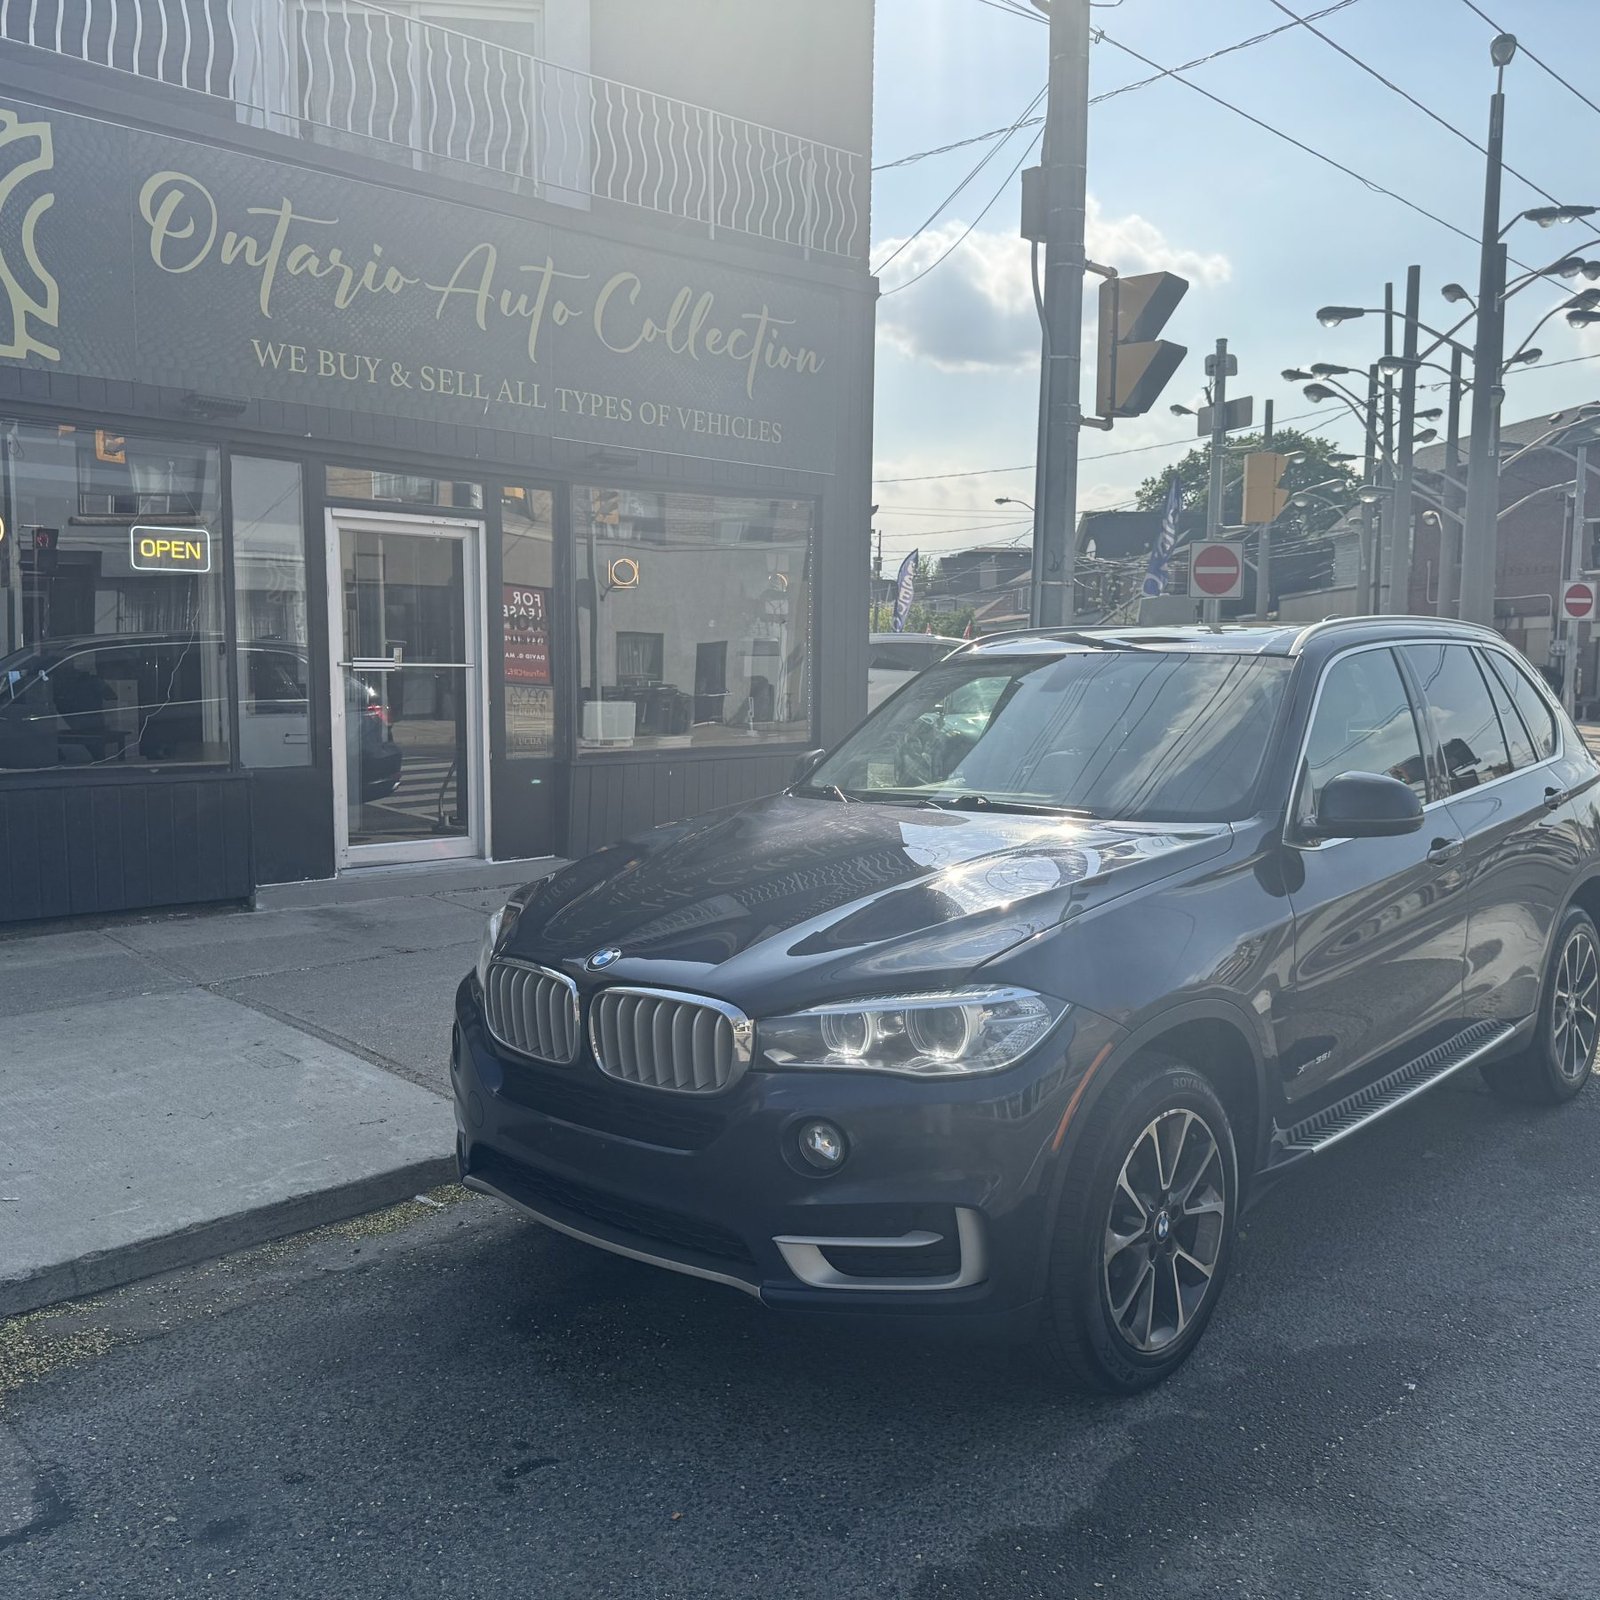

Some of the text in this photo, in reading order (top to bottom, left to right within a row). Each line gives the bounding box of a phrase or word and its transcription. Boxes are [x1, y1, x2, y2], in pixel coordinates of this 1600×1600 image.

[139, 171, 825, 400] Ontario Auto Collection
[251, 339, 308, 373] WE
[317, 349, 383, 384] BUY
[390, 361, 413, 389] &
[496, 378, 547, 409] ALL
[554, 387, 633, 422] TYPES
[639, 401, 670, 427] OF
[676, 406, 783, 444] VEHICLES
[140, 539, 201, 560] OPEN
